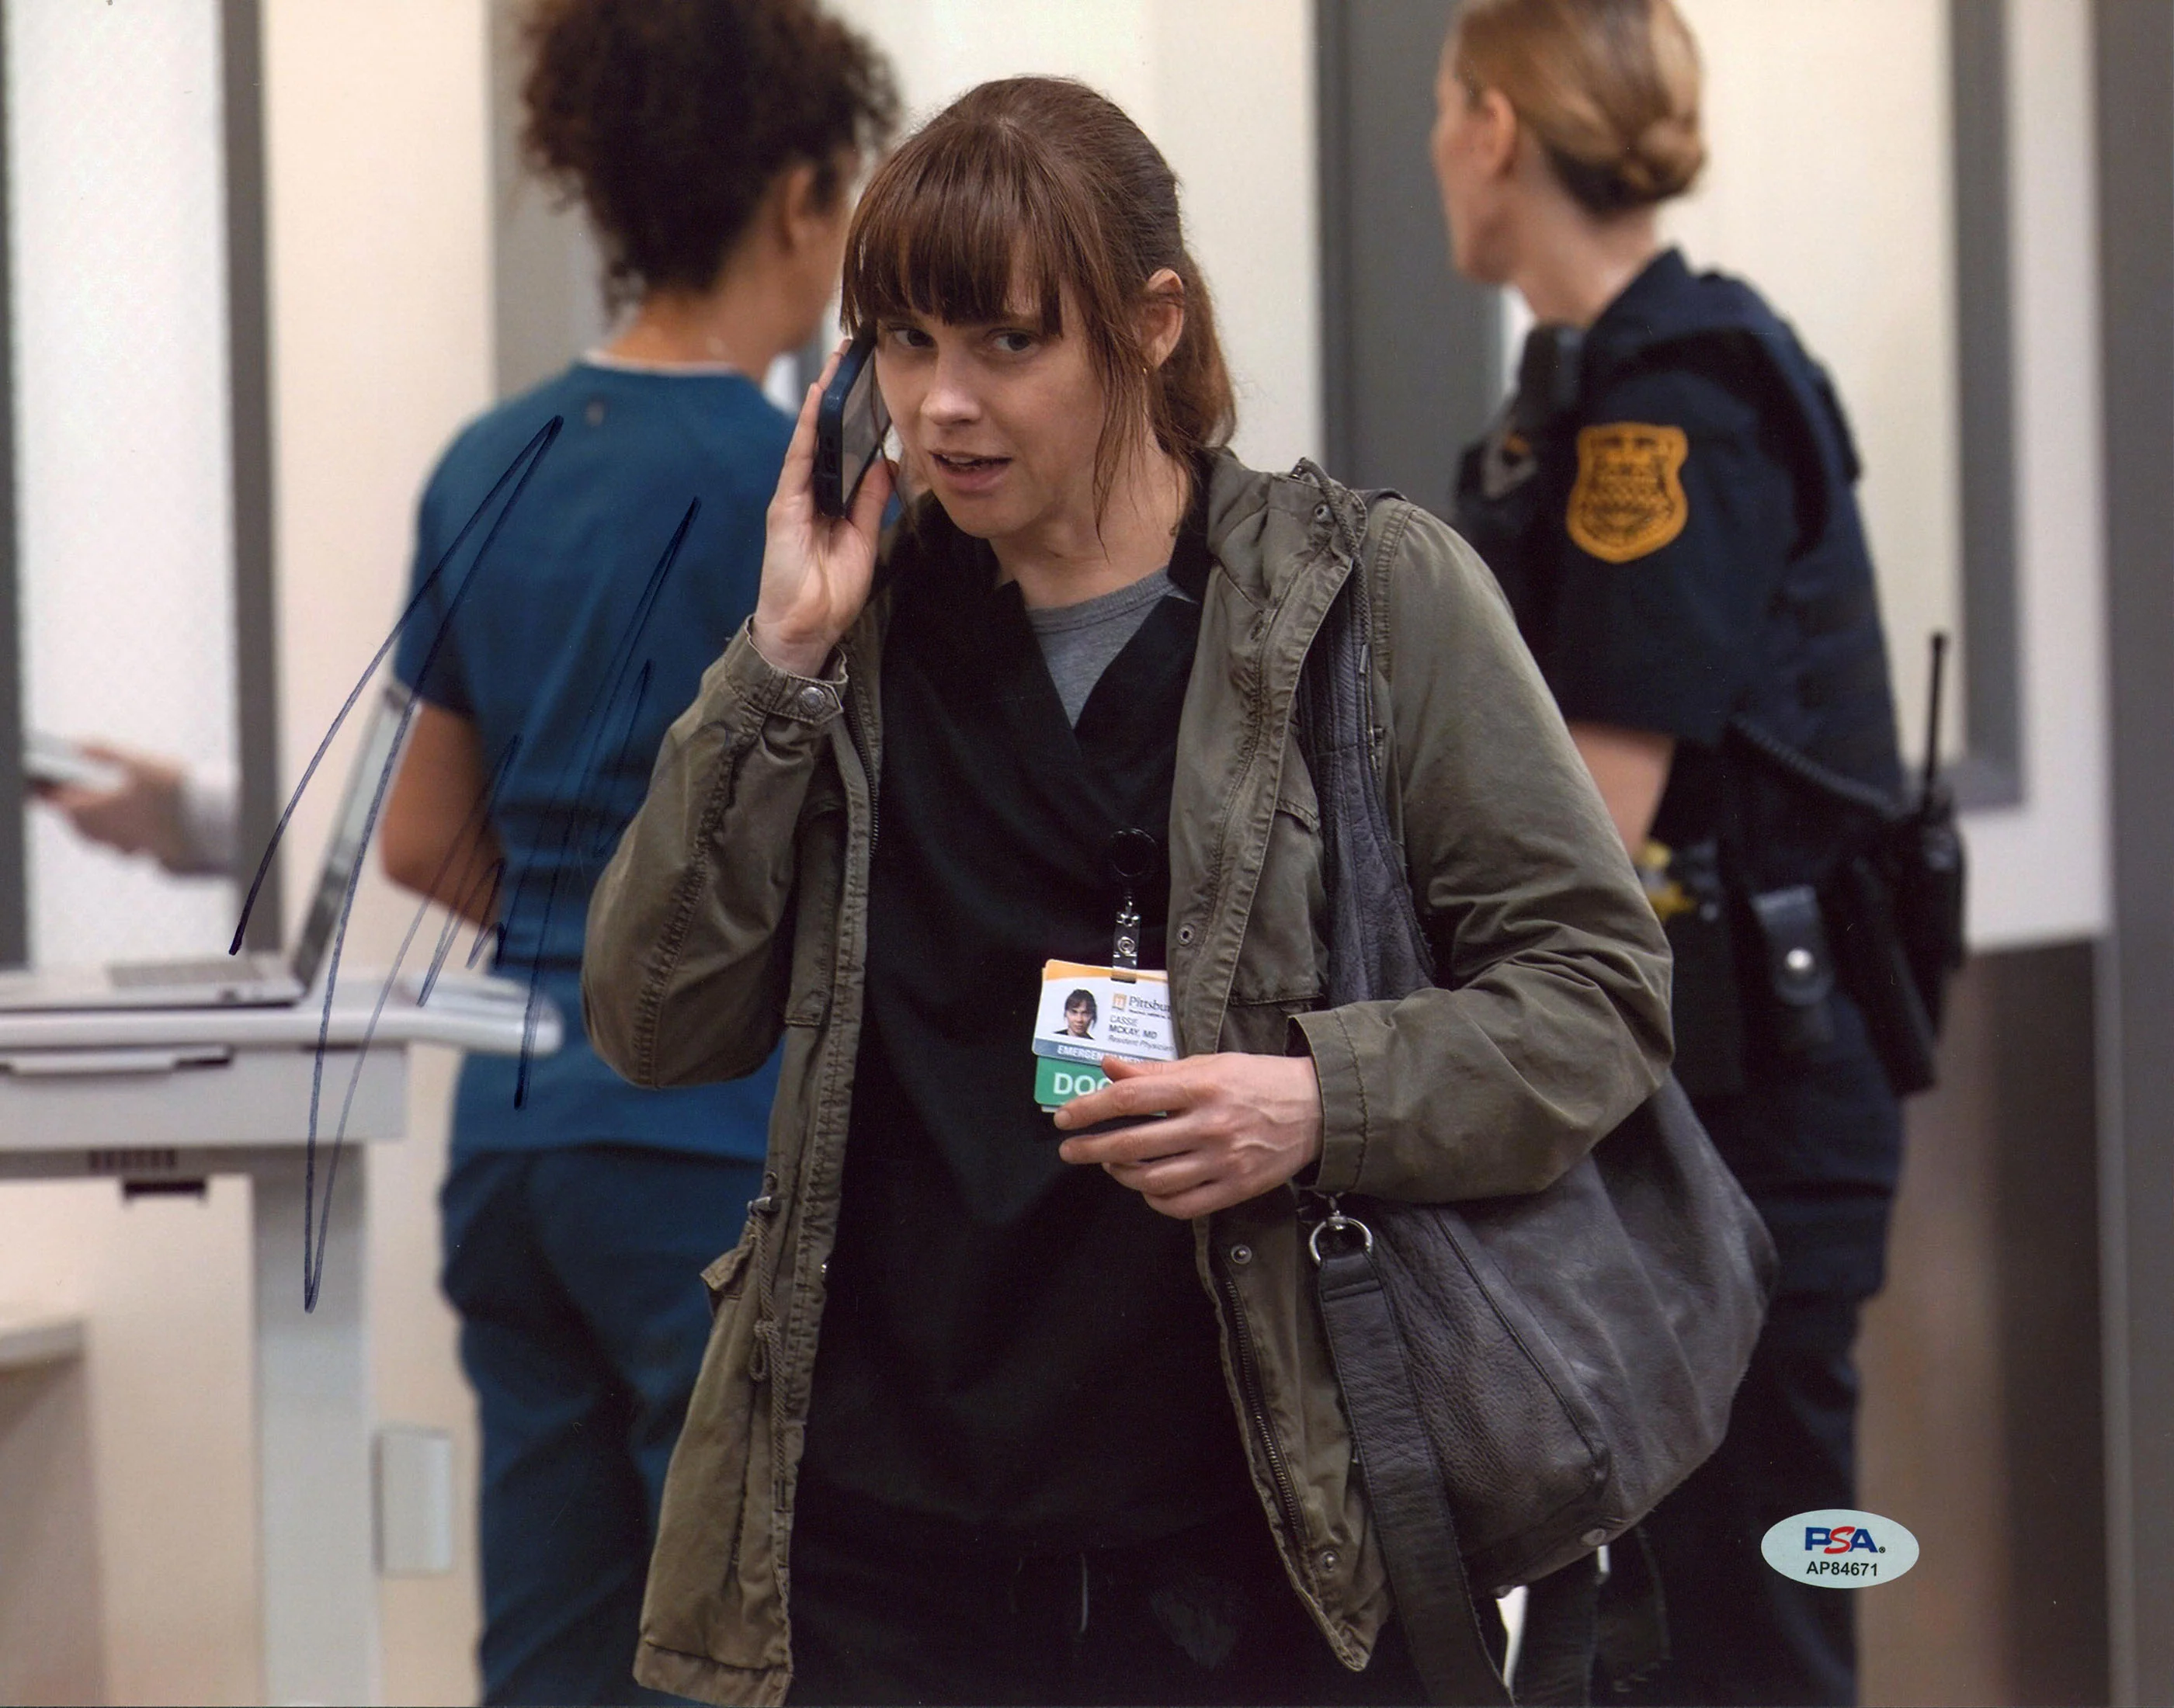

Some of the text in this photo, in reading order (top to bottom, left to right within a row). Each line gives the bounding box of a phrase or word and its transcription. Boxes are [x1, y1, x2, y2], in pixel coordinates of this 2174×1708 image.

[1110, 1015, 1138, 1026] CASSIE
[1143, 1029, 1158, 1039] MD
[1057, 1045, 1105, 1061] EMERGEN
